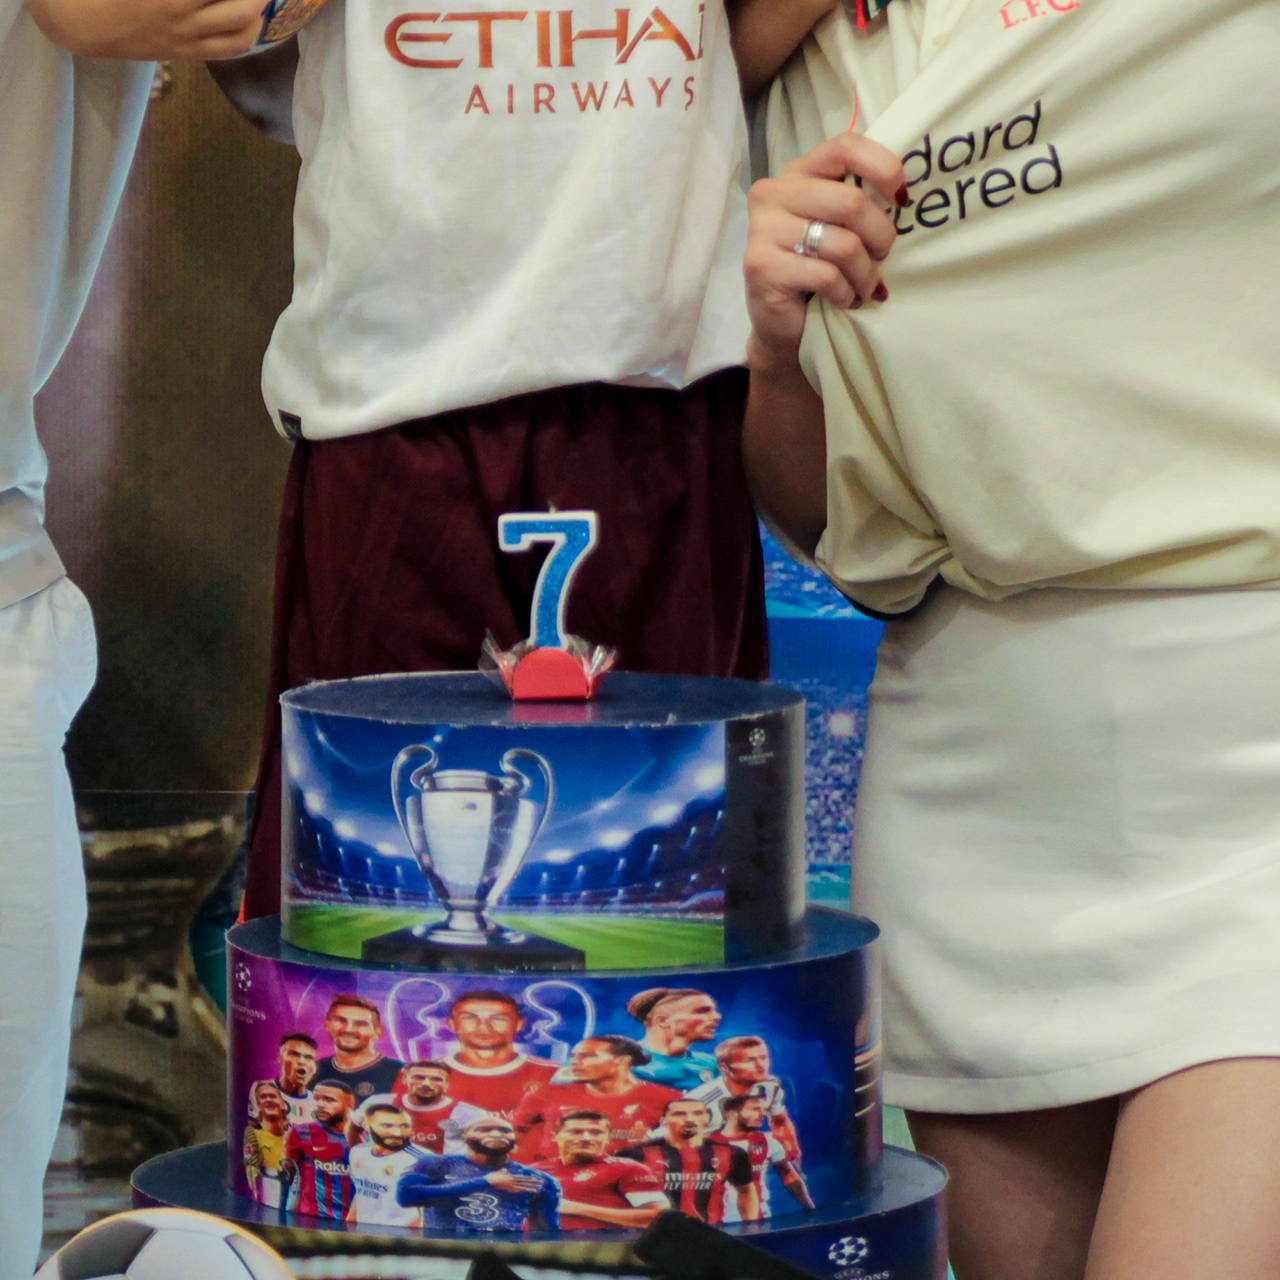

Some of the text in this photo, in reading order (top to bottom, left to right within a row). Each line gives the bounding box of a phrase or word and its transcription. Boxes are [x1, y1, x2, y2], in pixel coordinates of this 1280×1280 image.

[383, 3, 705, 69] ETIHA
[885, 142, 1063, 236] tered
[498, 510, 599, 650] 7
